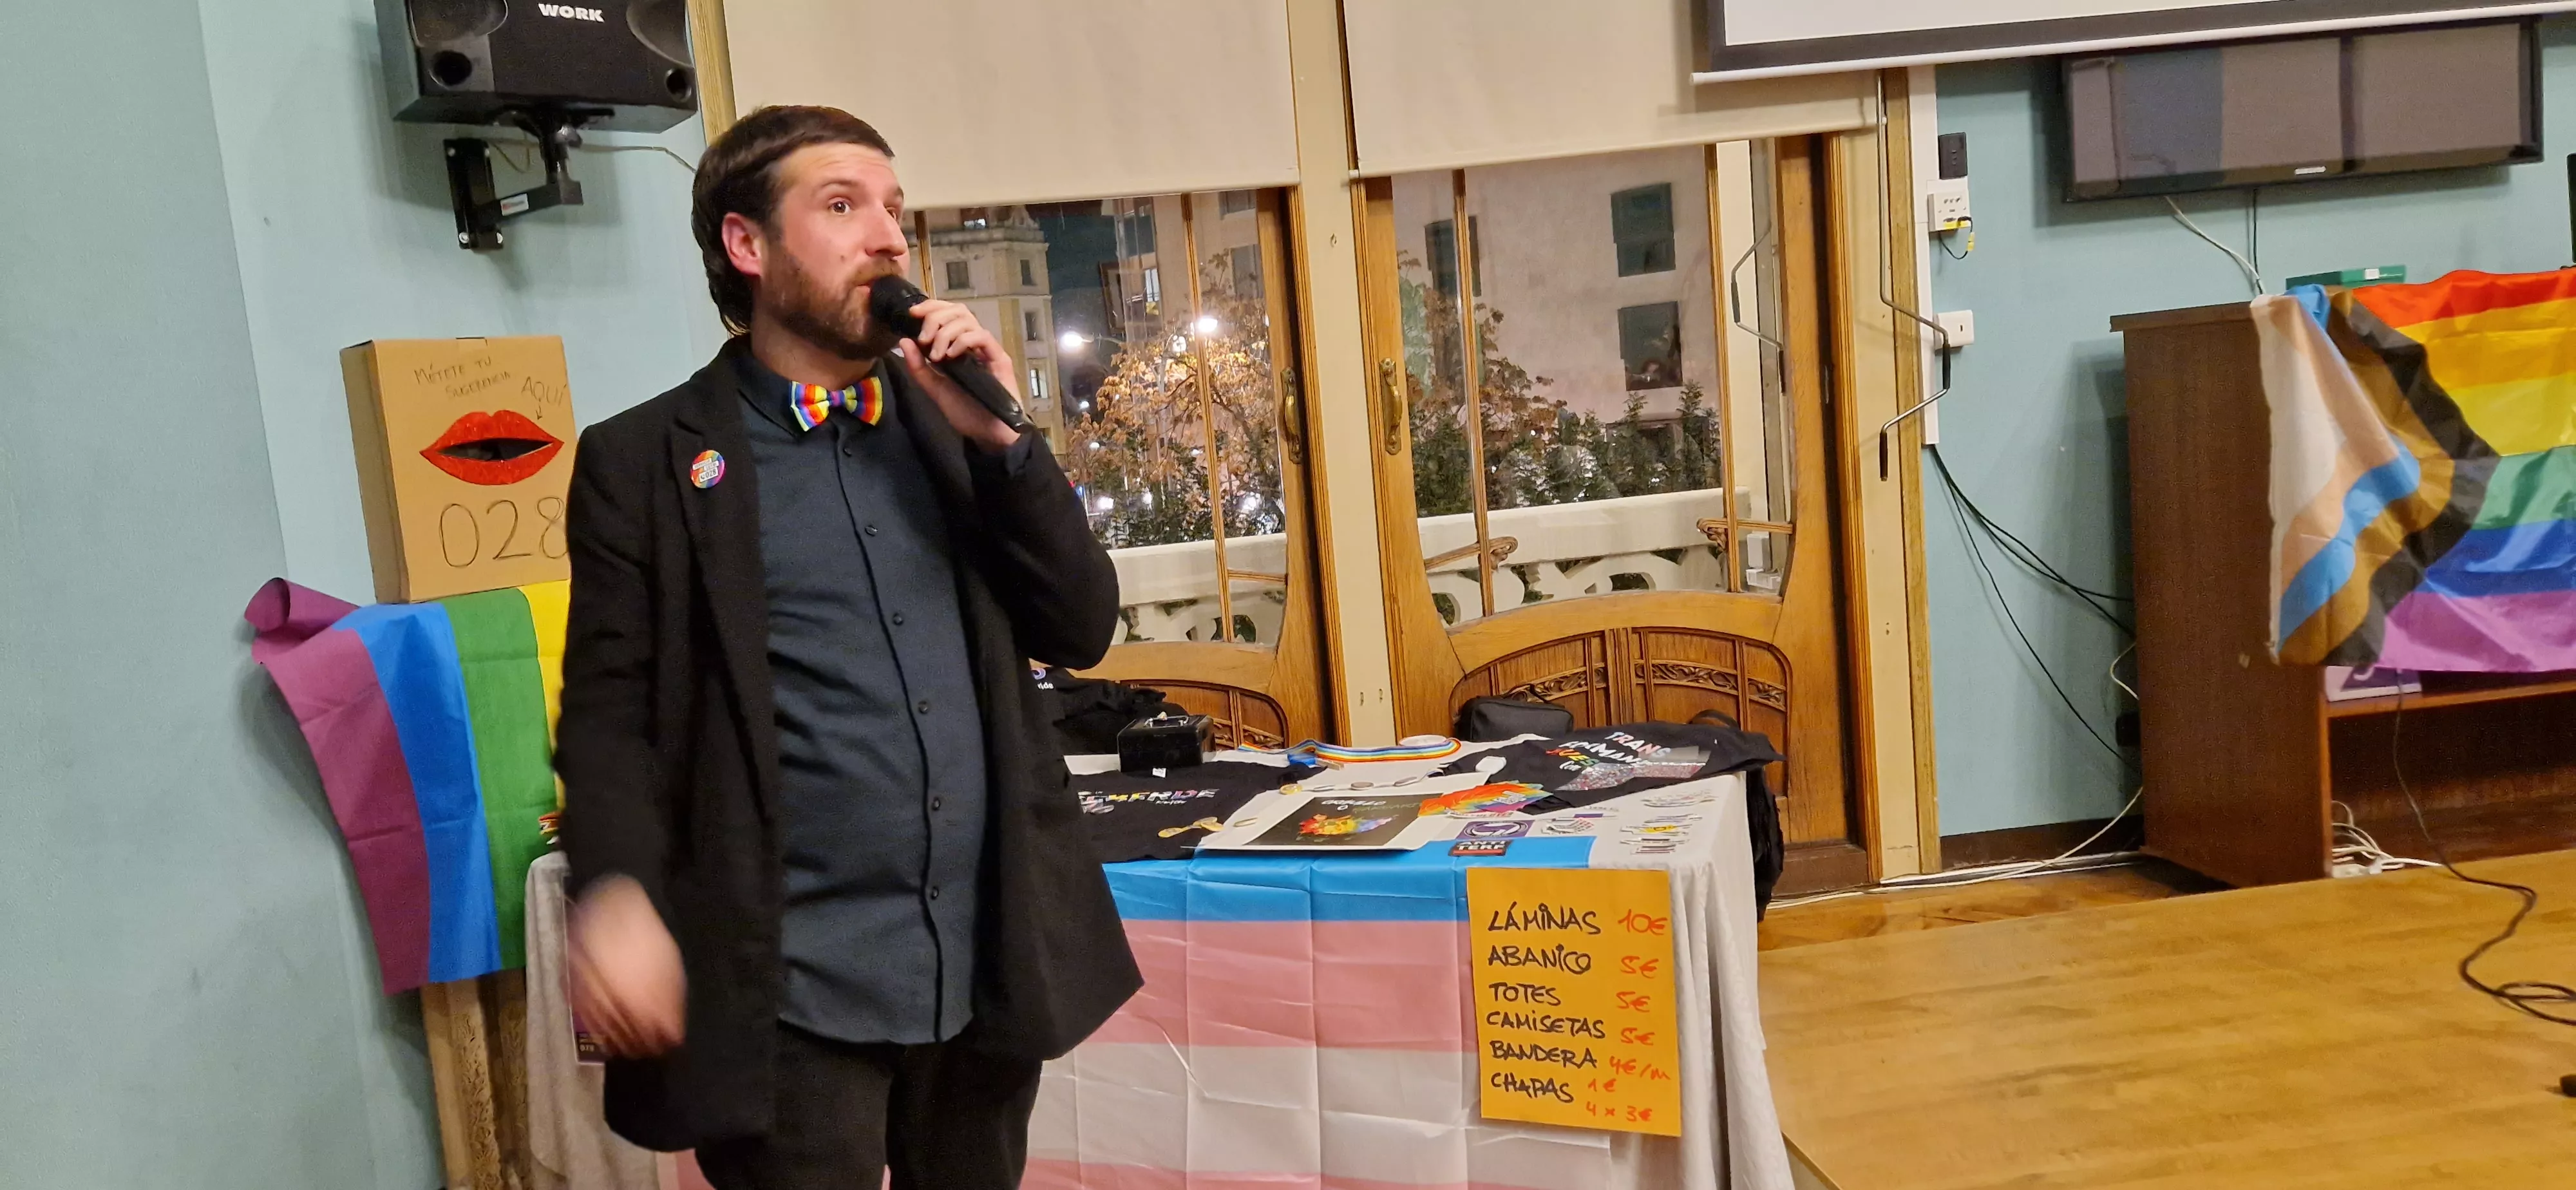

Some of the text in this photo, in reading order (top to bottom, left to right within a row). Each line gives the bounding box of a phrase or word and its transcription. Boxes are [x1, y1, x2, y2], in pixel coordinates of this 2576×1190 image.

[538, 3, 605, 23] WORK
[414, 355, 491, 385] MÉTETE TU
[521, 376, 567, 407] AQUÍ
[706, 468, 717, 478] 028
[439, 496, 571, 568] 028
[1037, 681, 1054, 690] ride
[1558, 741, 1643, 764] FORMAN
[1605, 732, 1671, 758] TRANS
[1488, 902, 1668, 935] LÁMINAS 10€
[1488, 944, 1660, 979] ABANICO 5€
[1488, 982, 1651, 1013] TOTES 5€
[1486, 1010, 1656, 1046] CAMISETAS 5€
[1489, 1040, 1598, 1069] BANDERA
[1490, 1072, 1575, 1103] CHAPAS
[1586, 1101, 1596, 1117] 4
[1626, 1105, 1653, 1122] 3€
